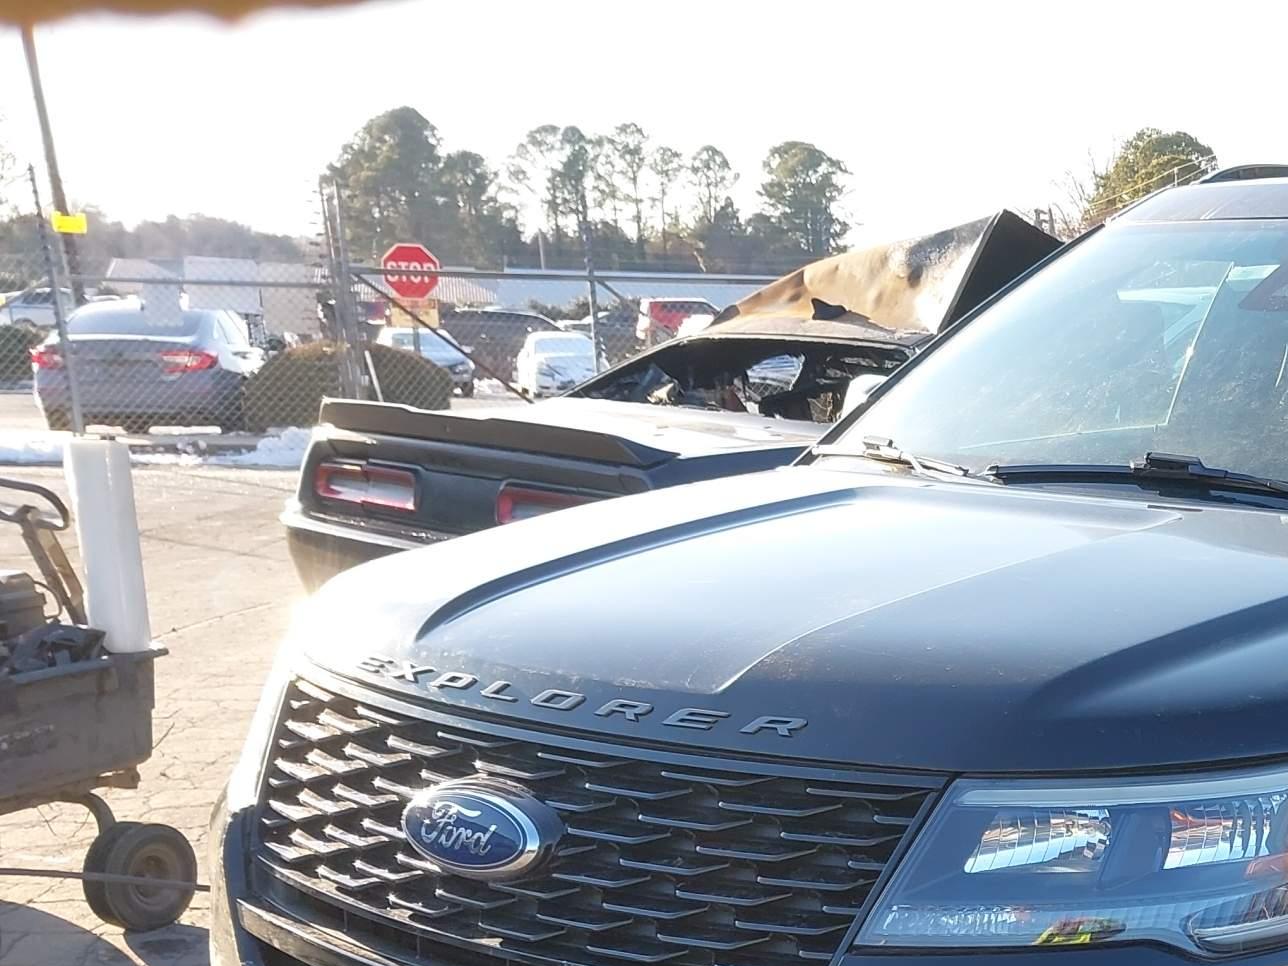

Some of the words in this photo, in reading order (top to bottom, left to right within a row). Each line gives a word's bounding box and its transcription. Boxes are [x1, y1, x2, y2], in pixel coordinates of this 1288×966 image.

[386, 260, 436, 284] STOP
[355, 655, 809, 738] EXPLORER
[420, 800, 498, 857] Ford
